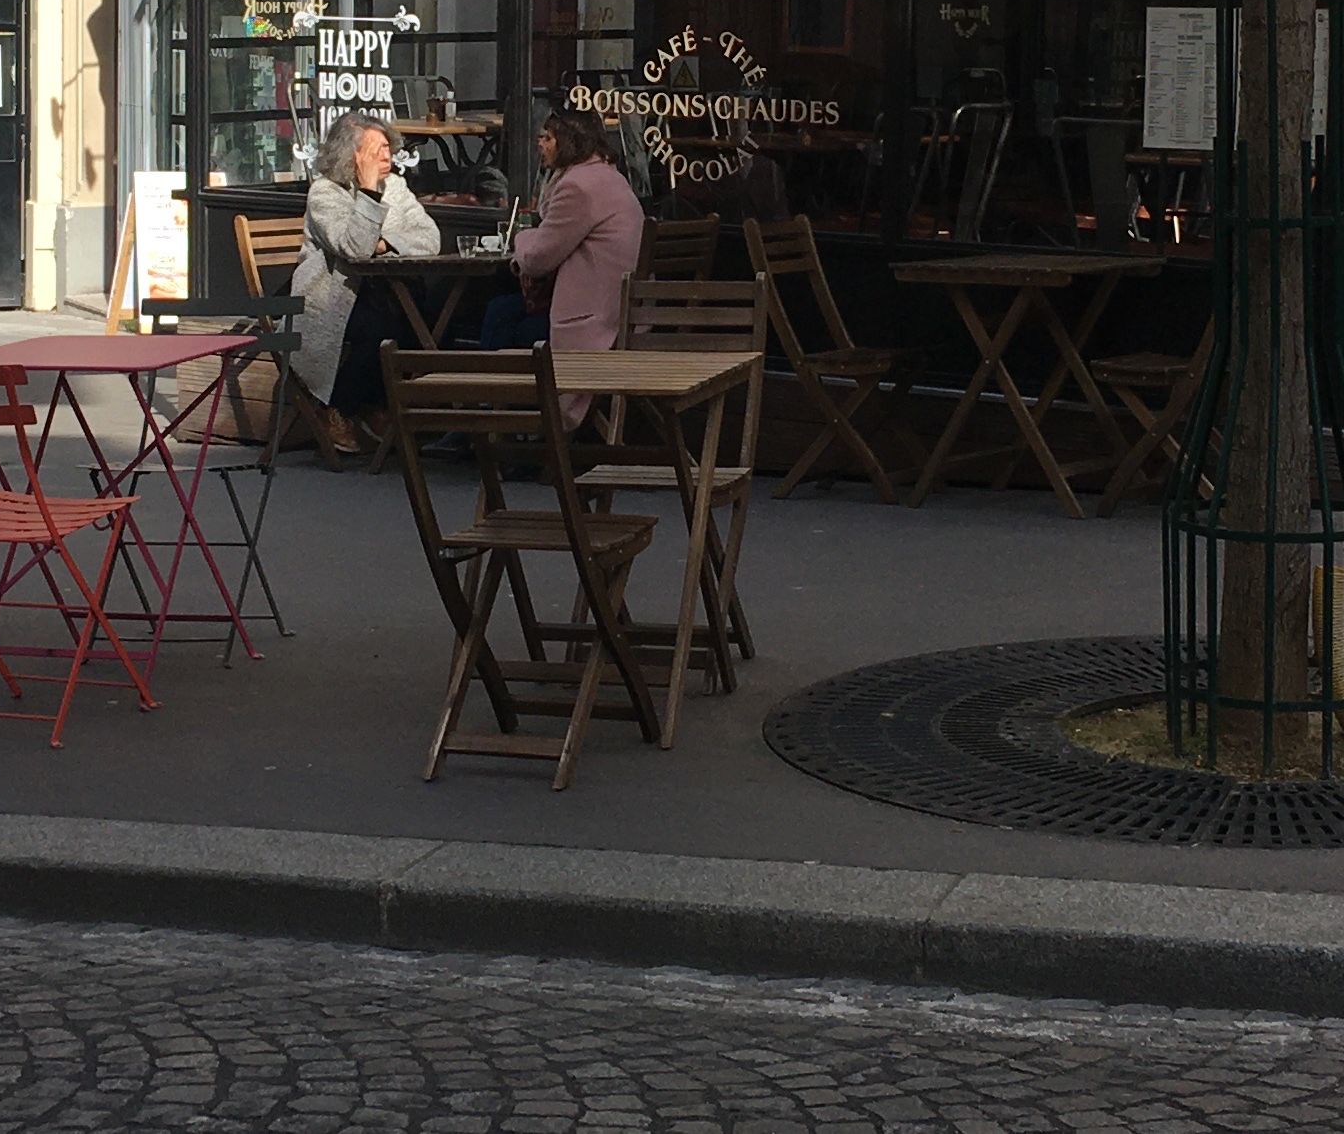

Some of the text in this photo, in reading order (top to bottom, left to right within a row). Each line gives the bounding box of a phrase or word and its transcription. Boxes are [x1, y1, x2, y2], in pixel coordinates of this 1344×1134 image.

[318, 29, 394, 68] HAPPY
[643, 25, 697, 83] CAFÉ
[718, 31, 767, 87] THÉ
[318, 72, 394, 103] HOUR
[570, 85, 840, 125] BOISSONS CHAUDES
[643, 125, 760, 189] CHOCOLAT
